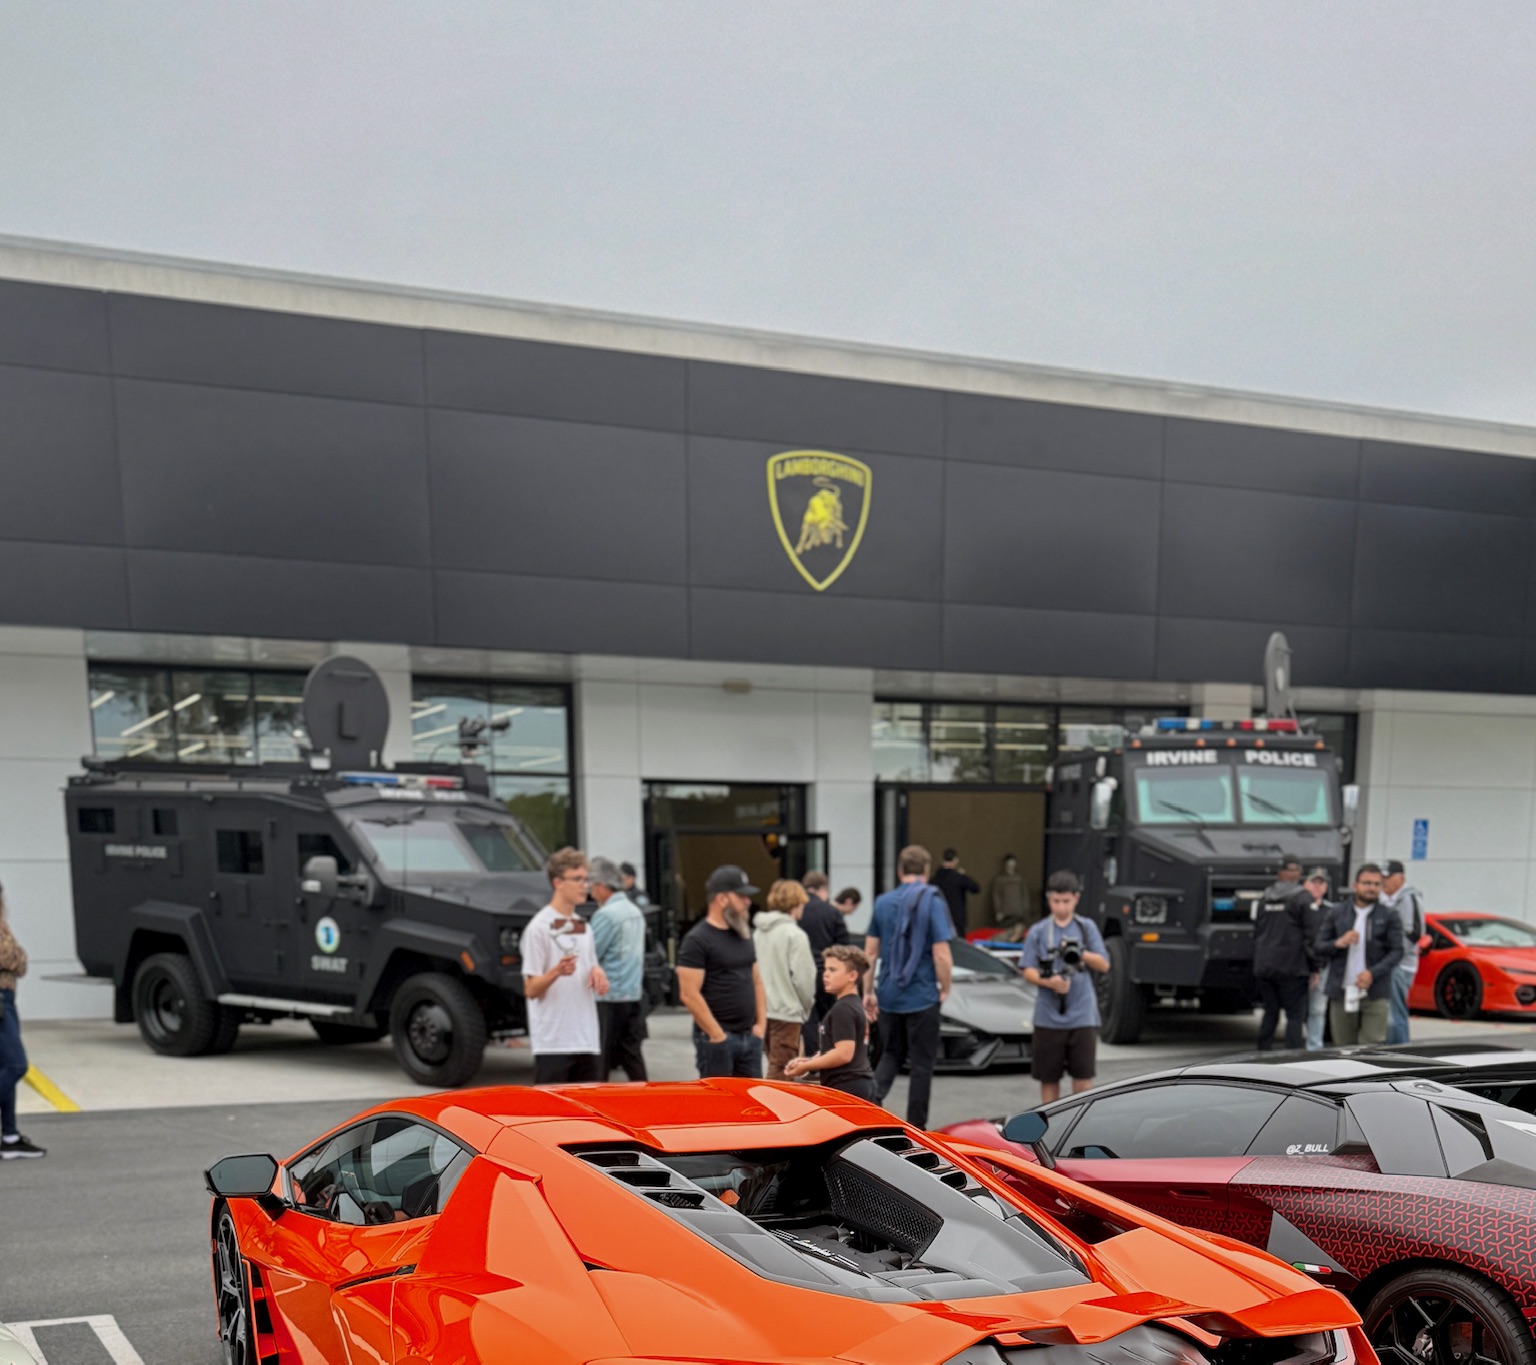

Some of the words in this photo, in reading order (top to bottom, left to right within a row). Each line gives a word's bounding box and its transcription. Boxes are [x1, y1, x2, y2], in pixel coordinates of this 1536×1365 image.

[775, 457, 866, 488] LAMBORGHINI
[1146, 750, 1218, 766] IRVINE
[1245, 750, 1317, 767] POLICE
[311, 954, 348, 973] SWAT
[1286, 1143, 1329, 1155] @Z_BULL
